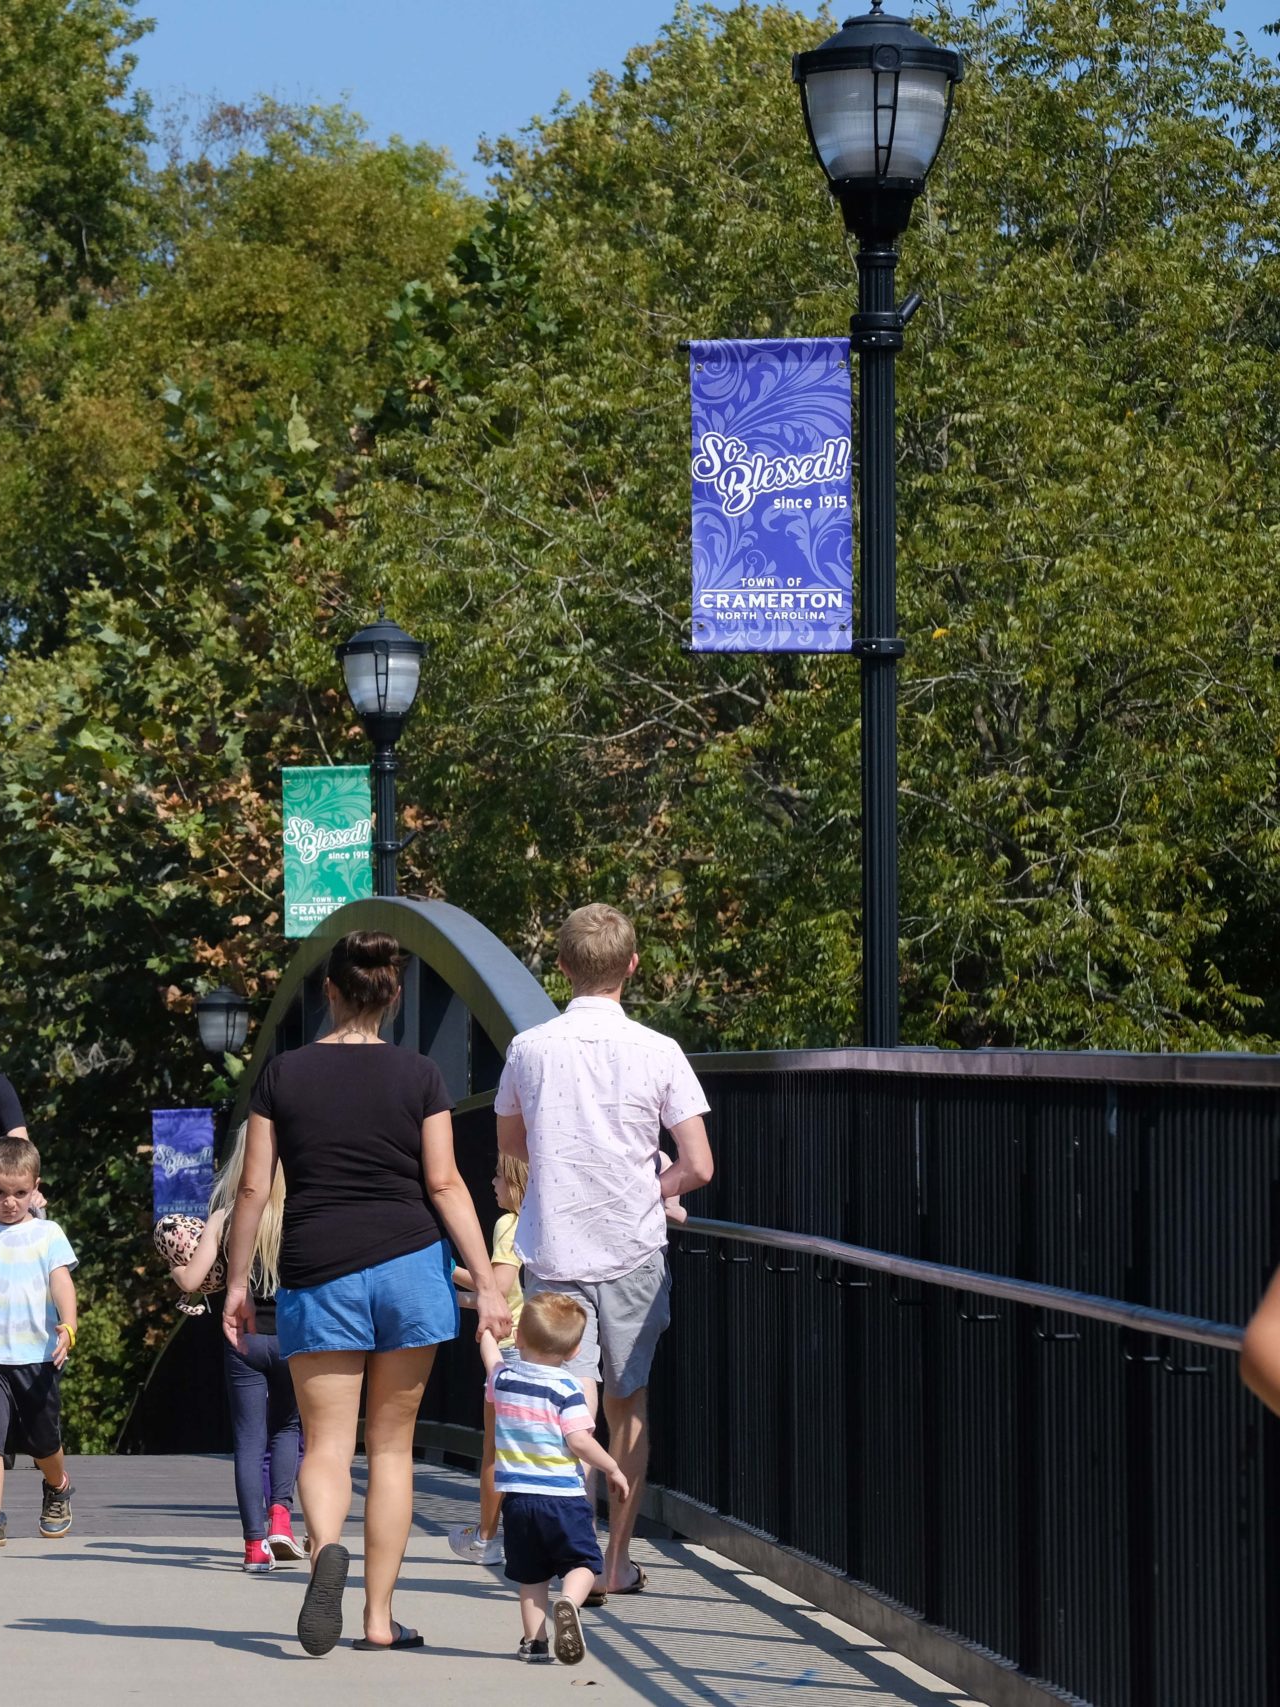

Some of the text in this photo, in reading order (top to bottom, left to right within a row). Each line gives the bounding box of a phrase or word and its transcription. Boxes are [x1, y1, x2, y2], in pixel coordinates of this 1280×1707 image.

[692, 432, 851, 516] So Blessed!
[773, 495, 847, 510] since 1915
[740, 577, 802, 588] TOWN OF
[700, 593, 843, 609] CRAMERTON
[716, 611, 826, 621] NORTH CAROLINA
[284, 817, 371, 864] So Blessed!
[328, 851, 370, 860] since 1915
